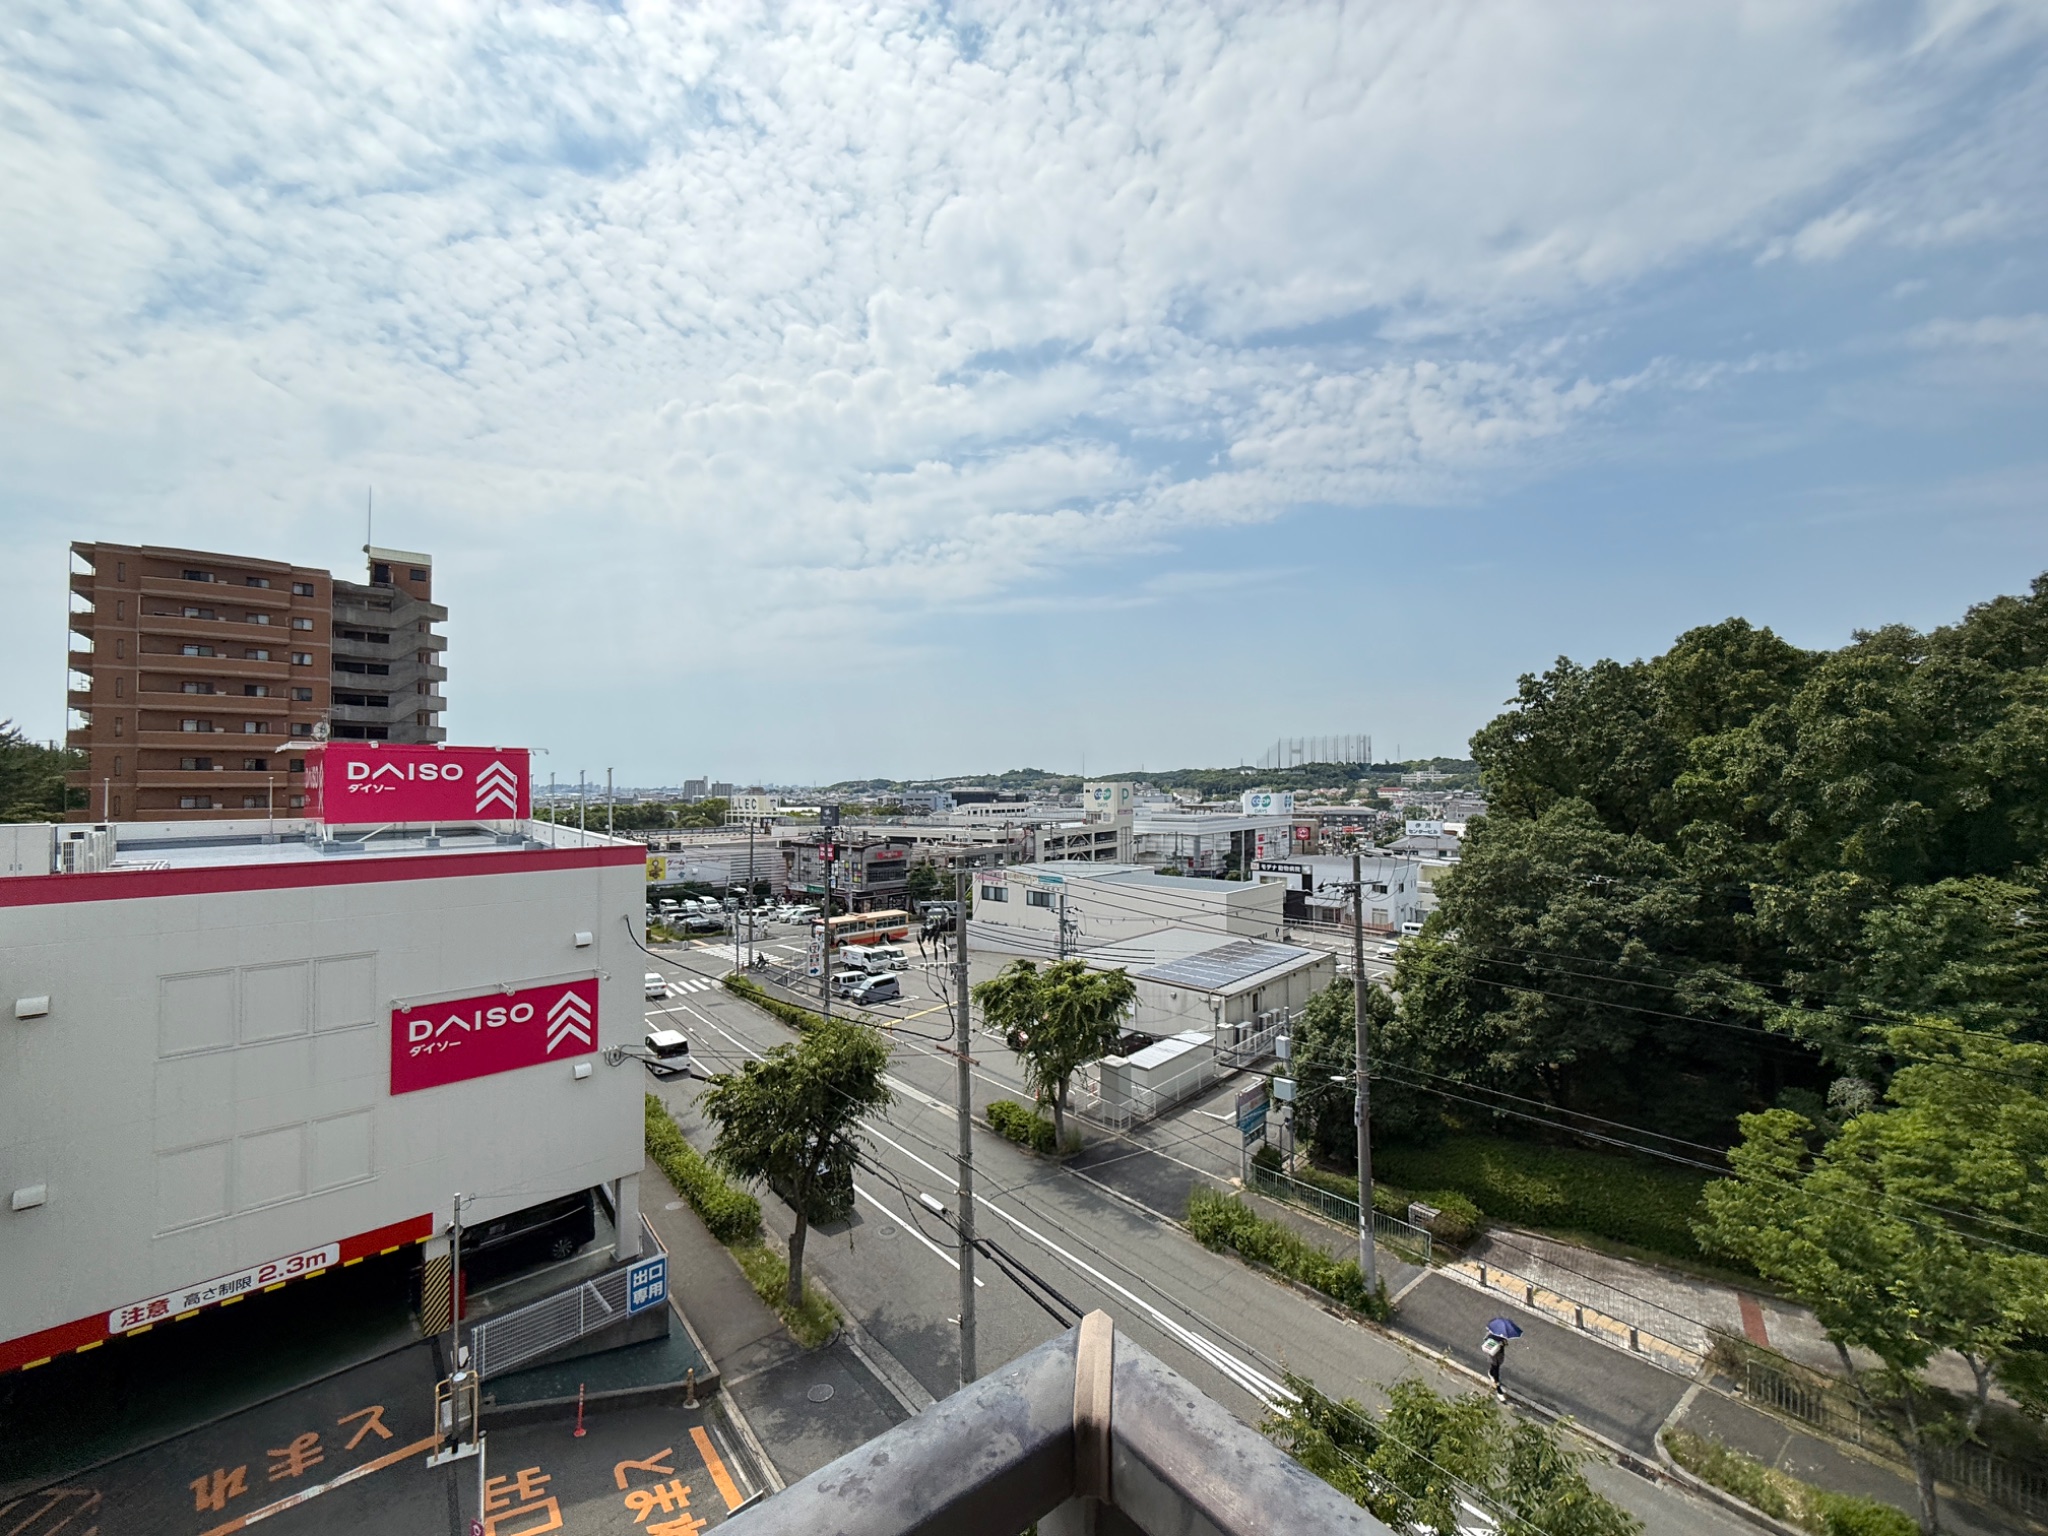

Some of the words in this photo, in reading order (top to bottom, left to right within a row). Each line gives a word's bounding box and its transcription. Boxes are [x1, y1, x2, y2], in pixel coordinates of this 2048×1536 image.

[347, 762, 463, 781] DAISO
[348, 783, 396, 794] ダイソー
[409, 1003, 534, 1042] DAISO
[409, 1041, 461, 1057] ダイソー
[633, 1263, 663, 1288] 出口
[120, 1297, 170, 1328] 注意
[183, 1275, 252, 1308] 高さ制限
[258, 1251, 327, 1284] 2.3m
[632, 1280, 663, 1305] 専用
